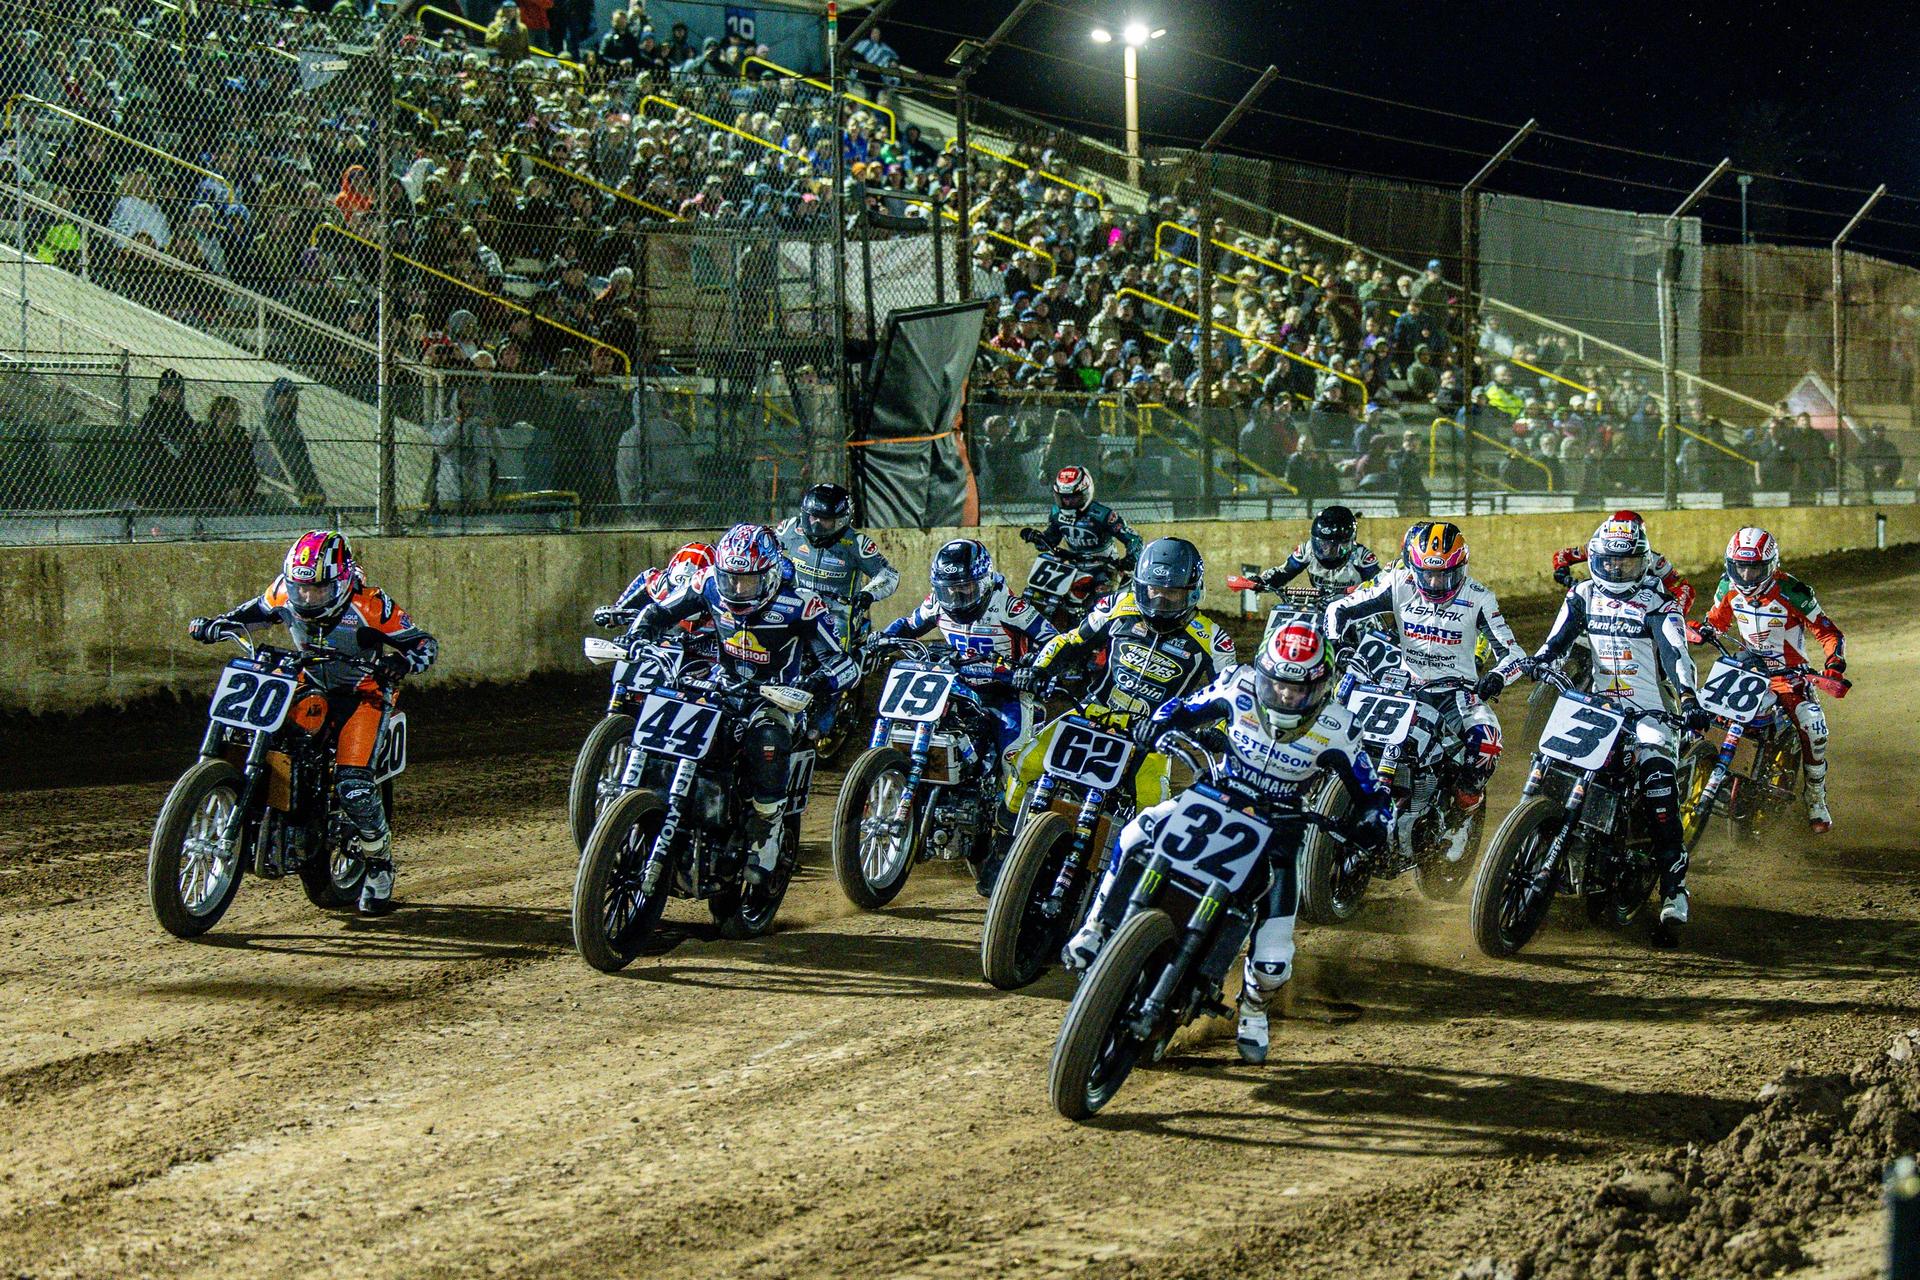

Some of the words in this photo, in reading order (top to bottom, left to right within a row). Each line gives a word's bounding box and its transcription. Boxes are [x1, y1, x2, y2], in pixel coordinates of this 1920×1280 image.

[728, 15, 755, 40] 10
[1607, 541, 1629, 550] Arai
[293, 568, 313, 577] Arai
[728, 558, 749, 567] Arai
[1029, 559, 1075, 592] 67
[1424, 558, 1444, 566] Arai
[765, 612, 782, 622] Arai
[1404, 621, 1463, 640] PARTS
[1588, 620, 1609, 630] PARTS
[1621, 623, 1642, 634] PLUS
[725, 644, 769, 663] mission
[1124, 652, 1176, 679] SHADES
[1280, 662, 1304, 676] Arai
[212, 672, 291, 728] 20
[882, 671, 950, 716] 19
[1117, 673, 1163, 700] Corbin
[1704, 669, 1766, 713] 48
[638, 700, 718, 758] 44
[1318, 716, 1340, 729] Arai
[1356, 696, 1411, 736] 18
[1812, 719, 1827, 735] 48
[1541, 707, 1618, 759] 3
[376, 721, 405, 777] 20
[1050, 724, 1126, 783] 62
[1233, 730, 1313, 769] ESTENSON
[785, 757, 815, 815] 44
[1242, 765, 1299, 793] YAMAHA
[659, 803, 682, 856] MOLY
[1161, 803, 1260, 884] 32
